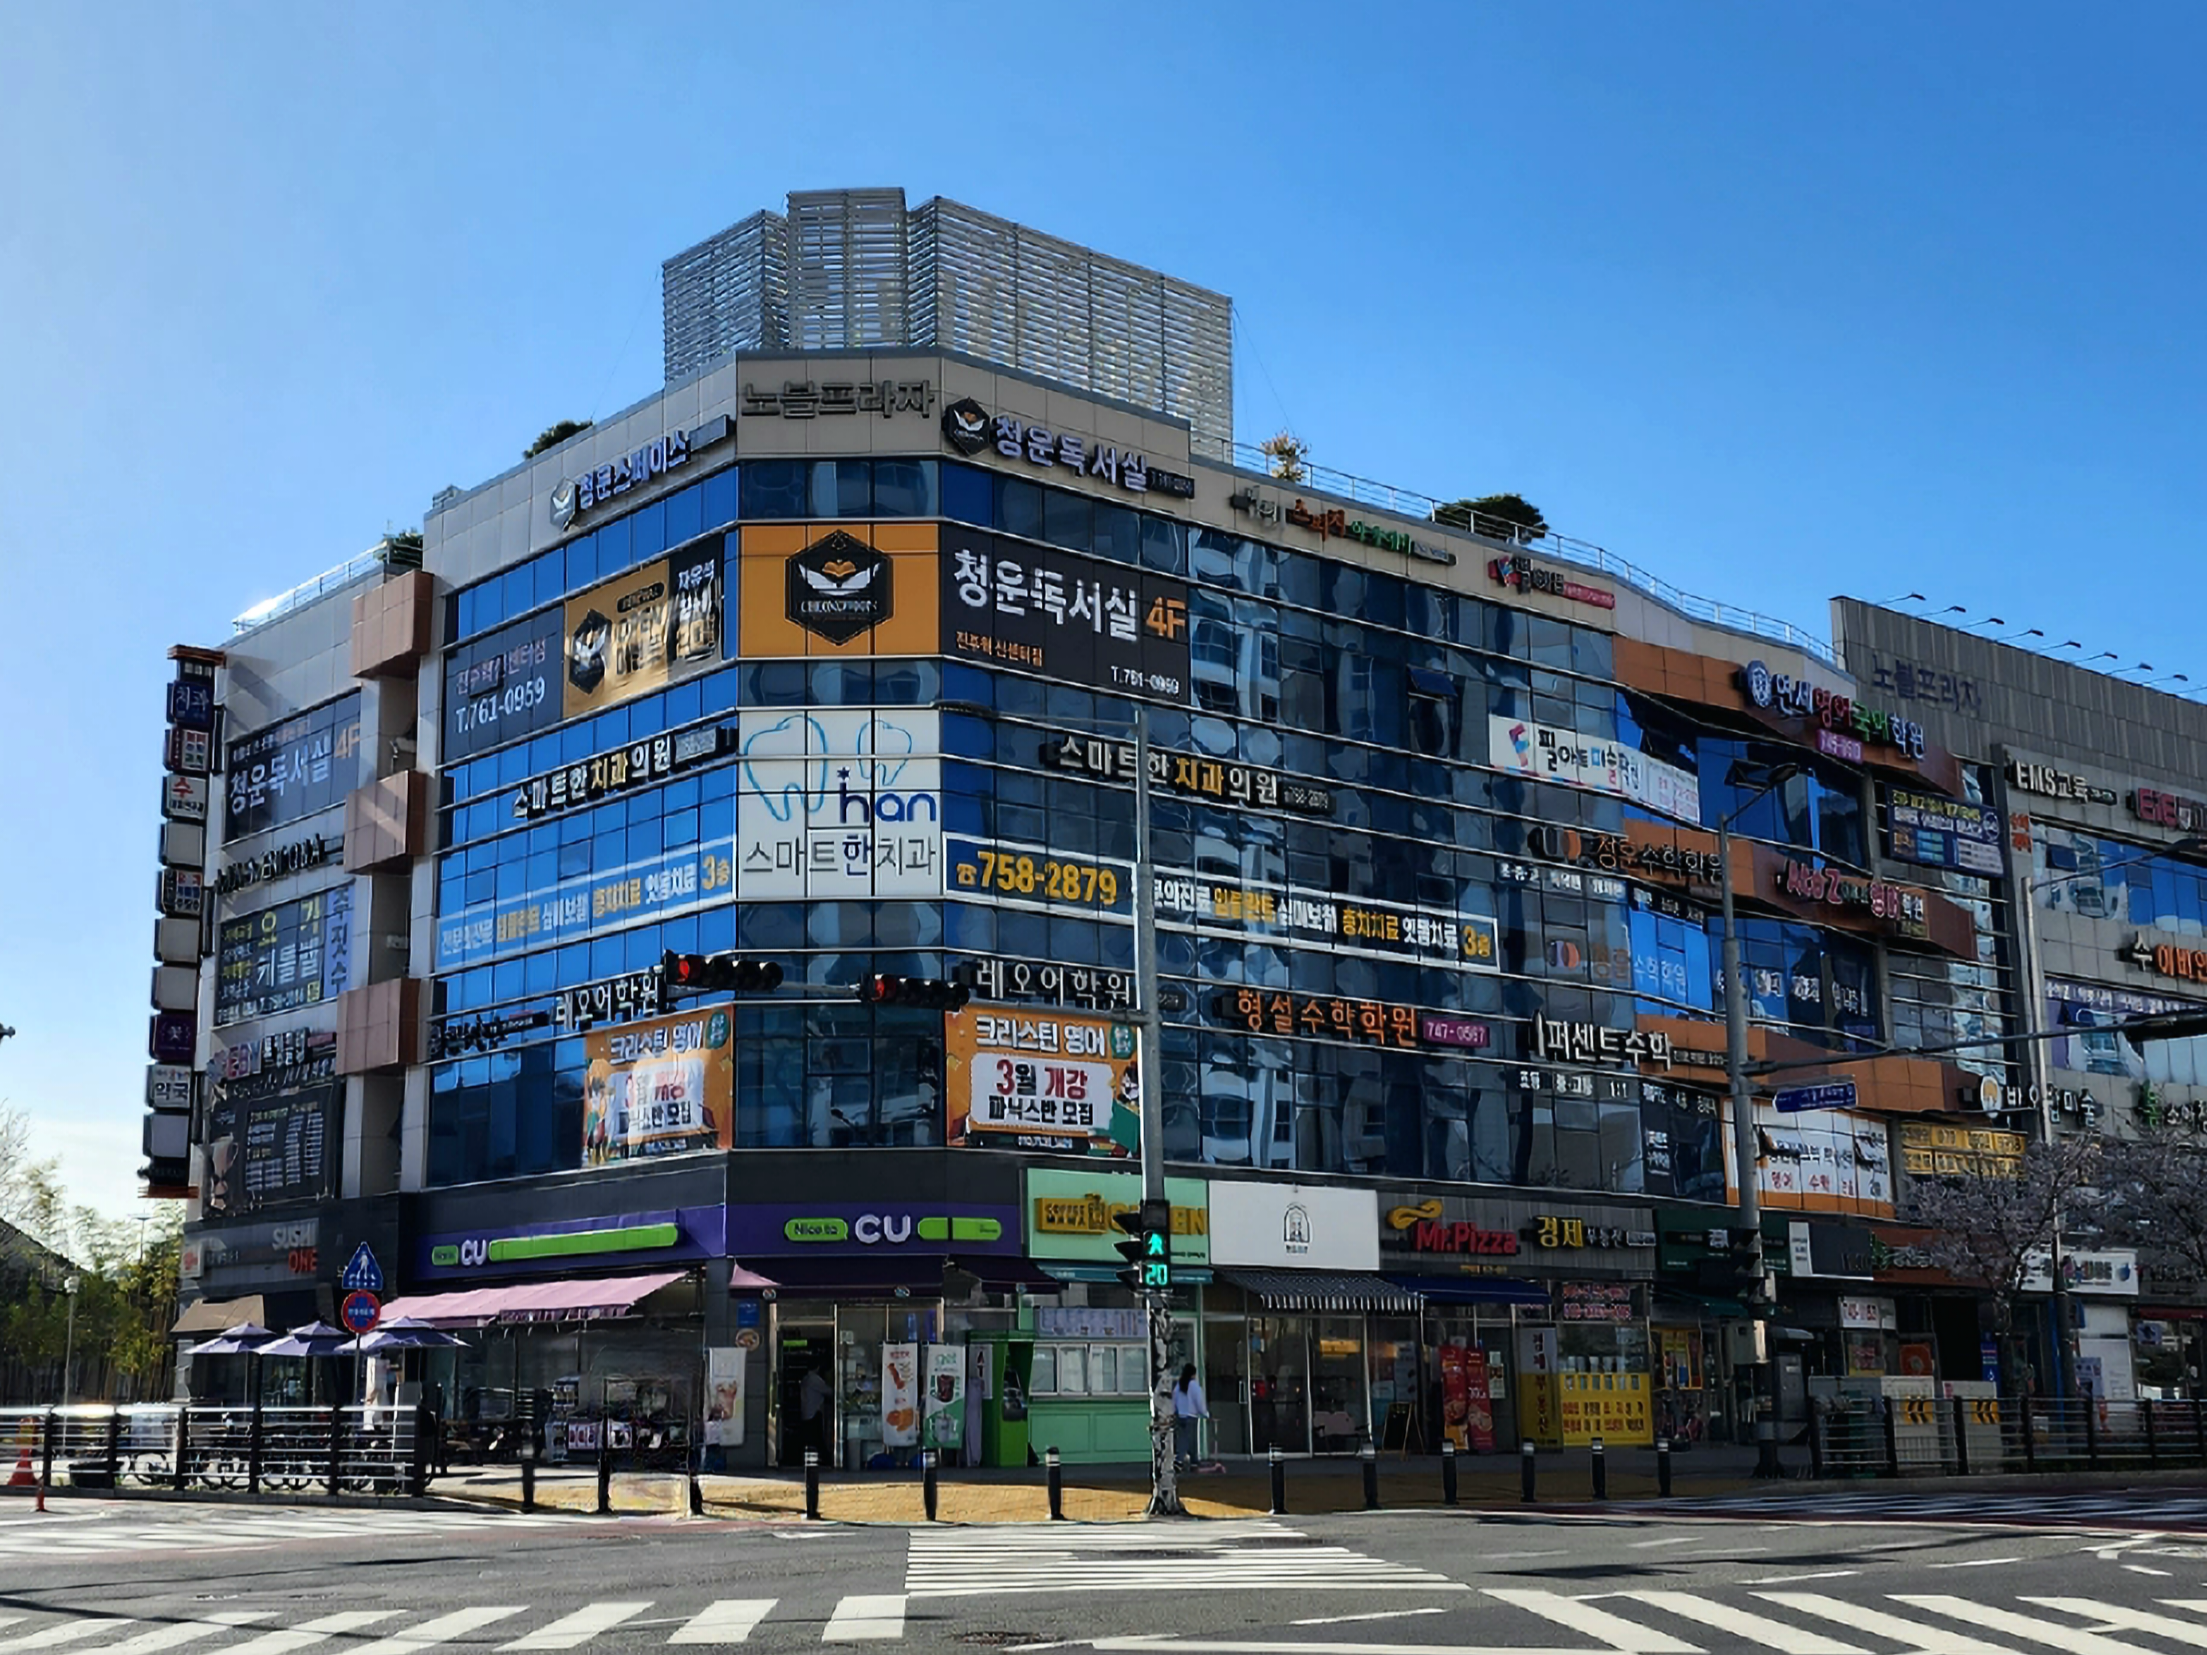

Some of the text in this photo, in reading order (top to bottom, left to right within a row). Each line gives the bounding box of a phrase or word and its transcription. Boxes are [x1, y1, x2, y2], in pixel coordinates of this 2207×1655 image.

[996, 415, 1149, 492] 청운독서실
[953, 547, 1187, 643] 청운독서실 4F
[455, 676, 546, 734] T.761-0959
[229, 731, 331, 817] 청운독서실
[334, 721, 361, 760] 4F
[512, 735, 672, 819] 스마트한치과의원
[1058, 735, 1278, 807] 스마트한치과의원
[701, 854, 730, 891] 3층
[742, 833, 937, 877] 스마트한치과
[976, 850, 1118, 905] 758-2879
[1402, 916, 1459, 951] 잇몸치료
[555, 972, 659, 1031] 레오어학원
[976, 959, 1131, 1010] 레오어학원
[975, 1015, 1106, 1058] 크리스틴 영어
[1237, 988, 1418, 1048] 형설수학학원
[995, 1058, 1089, 1101] 3월 개강
[988, 1094, 1094, 1126] 파닉스반 모집
[271, 1217, 317, 1251] SUSHI
[854, 1213, 911, 1244] CU
[1416, 1220, 1518, 1254] Mr.Pizza
[1537, 1216, 1583, 1248] 경제
[288, 1247, 318, 1273] ONE
[460, 1238, 487, 1266] CU
[1145, 1263, 1168, 1287] 20
